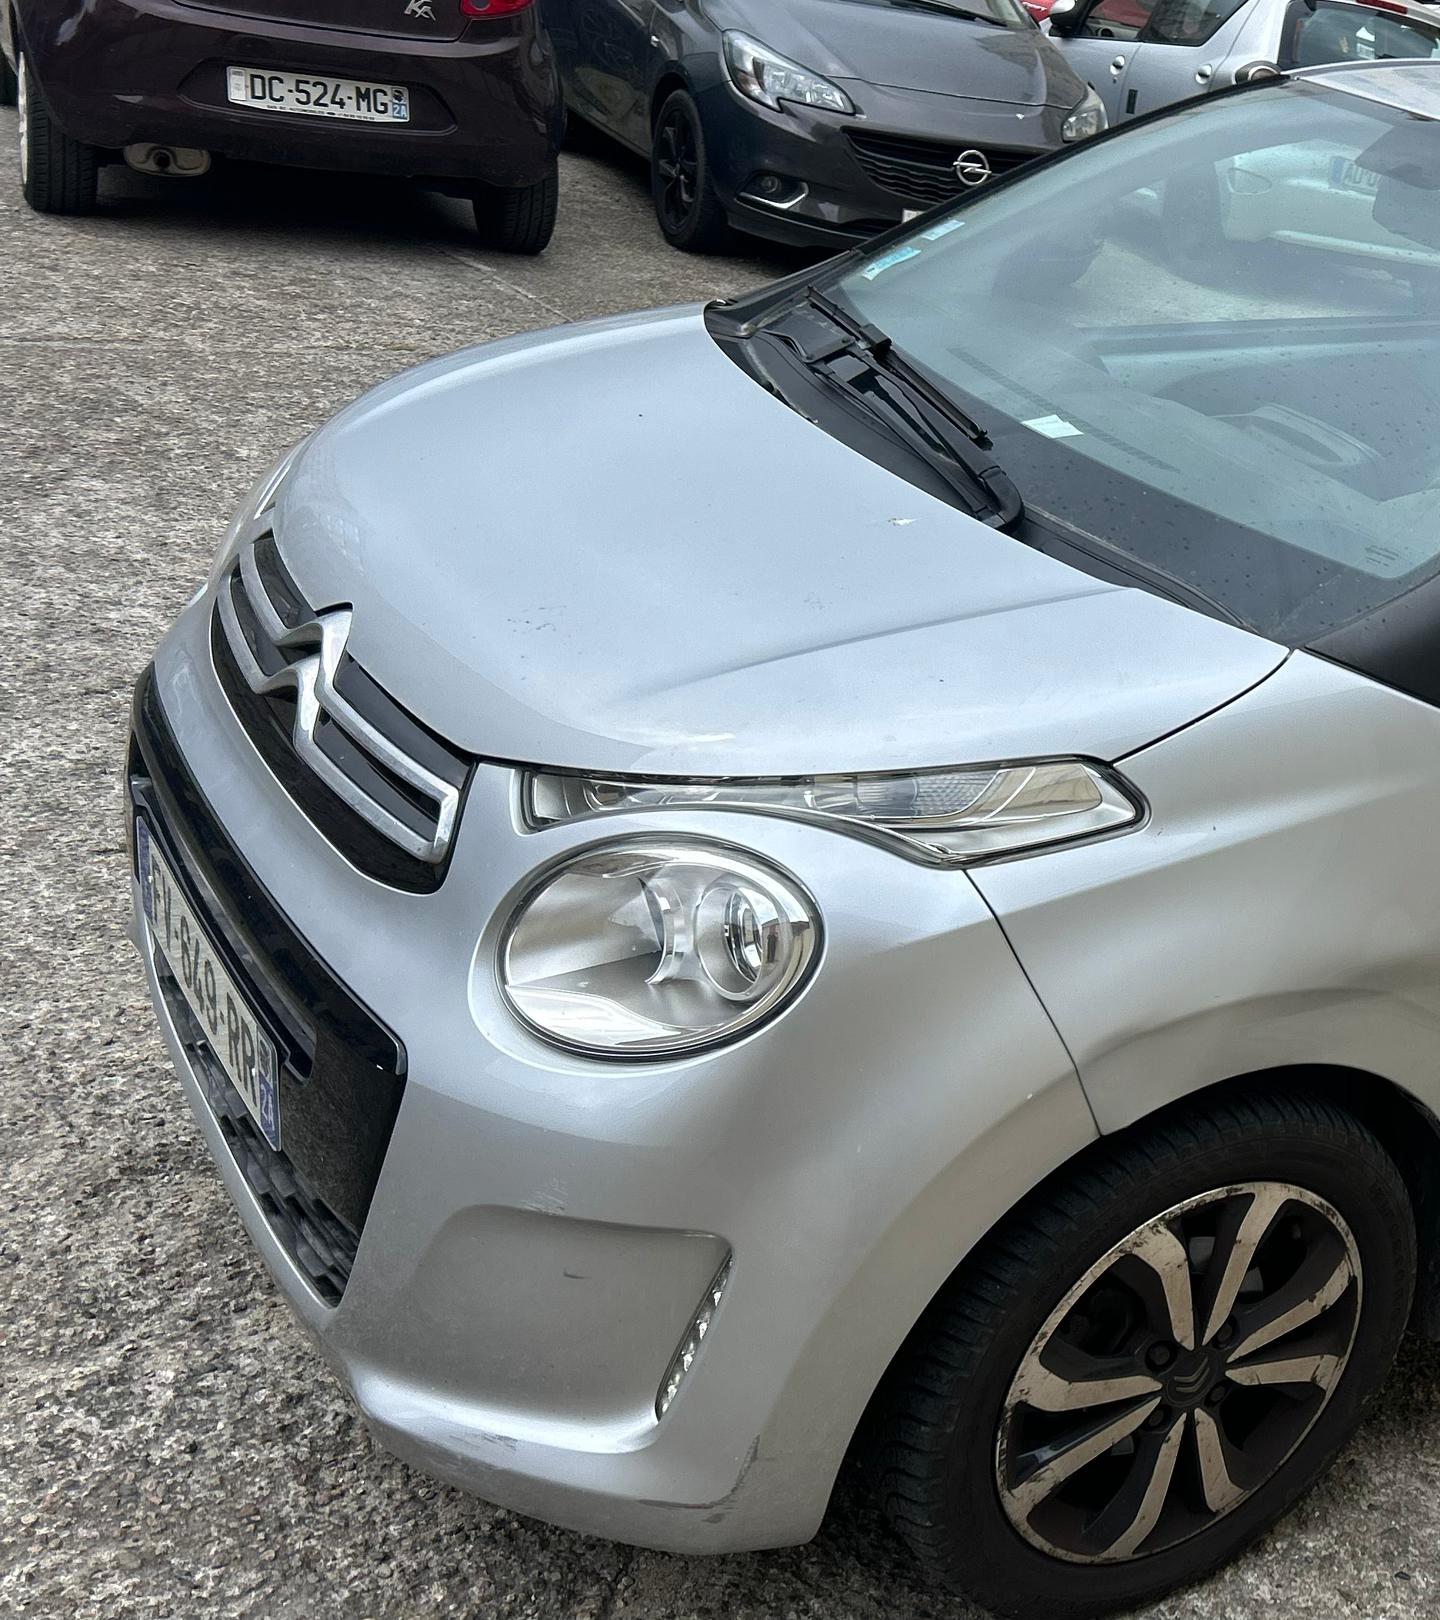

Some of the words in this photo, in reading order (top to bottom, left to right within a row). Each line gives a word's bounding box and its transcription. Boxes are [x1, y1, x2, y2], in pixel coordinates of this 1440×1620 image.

[250, 74, 388, 114] DC-524-MG
[393, 104, 407, 118] 2A
[151, 855, 258, 1108] FV-649-RR
